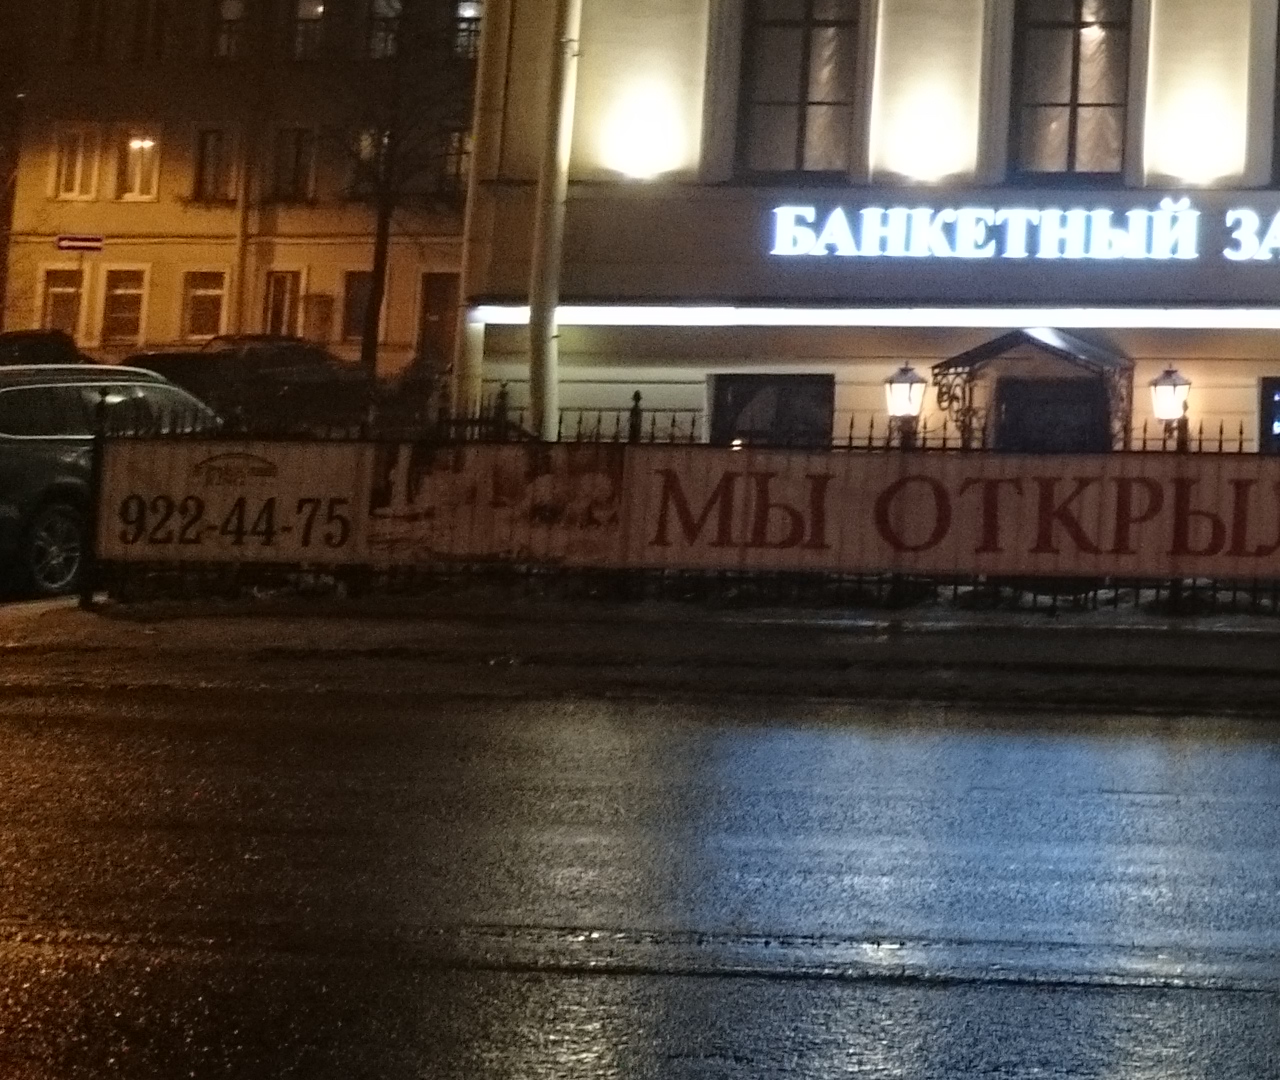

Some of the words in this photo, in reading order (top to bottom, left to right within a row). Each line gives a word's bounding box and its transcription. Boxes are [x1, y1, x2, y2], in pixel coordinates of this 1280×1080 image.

[769, 197, 1201, 259] БАНКЕТНЫЙ
[117, 493, 351, 549] 922-44-75
[648, 467, 836, 550] МЫ
